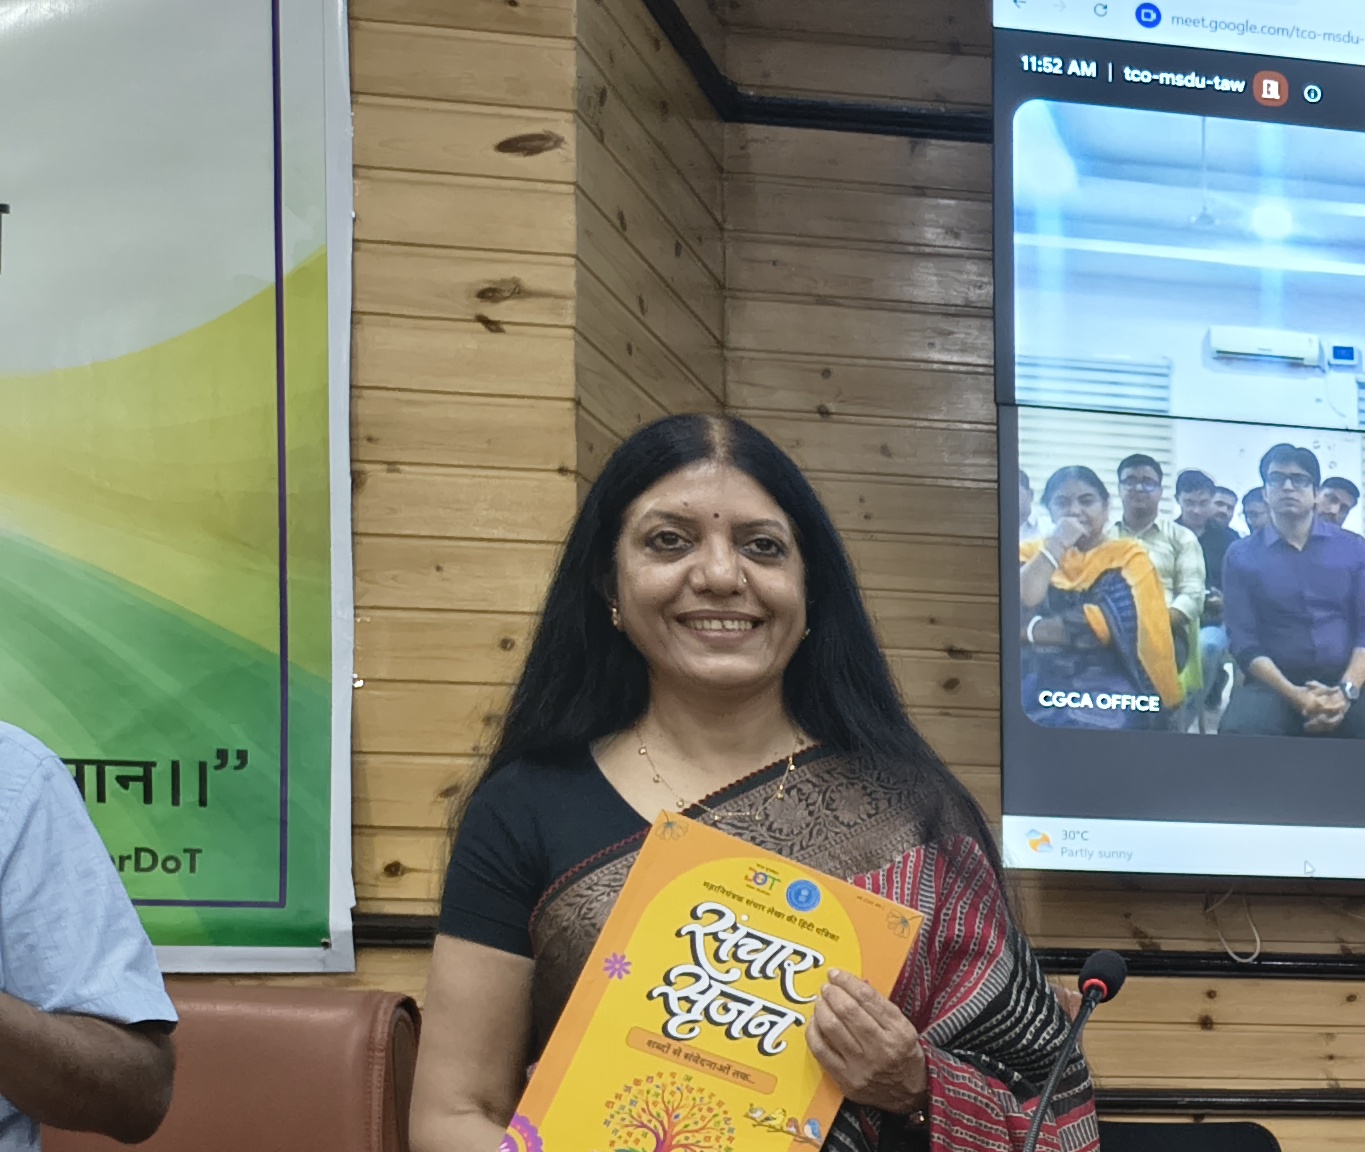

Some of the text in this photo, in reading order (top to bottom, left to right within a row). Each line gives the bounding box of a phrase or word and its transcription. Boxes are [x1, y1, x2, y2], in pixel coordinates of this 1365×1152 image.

[1020, 55, 1063, 75] 11:52
[1067, 59, 1097, 77] AM
[1123, 66, 1246, 93] tco-msdu-taw
[1039, 690, 1160, 712] CGCA OFFICE
[1061, 830, 1089, 841] 30°C
[111, 847, 202, 874] rDoT
[1061, 847, 1133, 861] Partly sunny
[675, 901, 825, 1004] संचार
[646, 964, 806, 1057] सृजन
